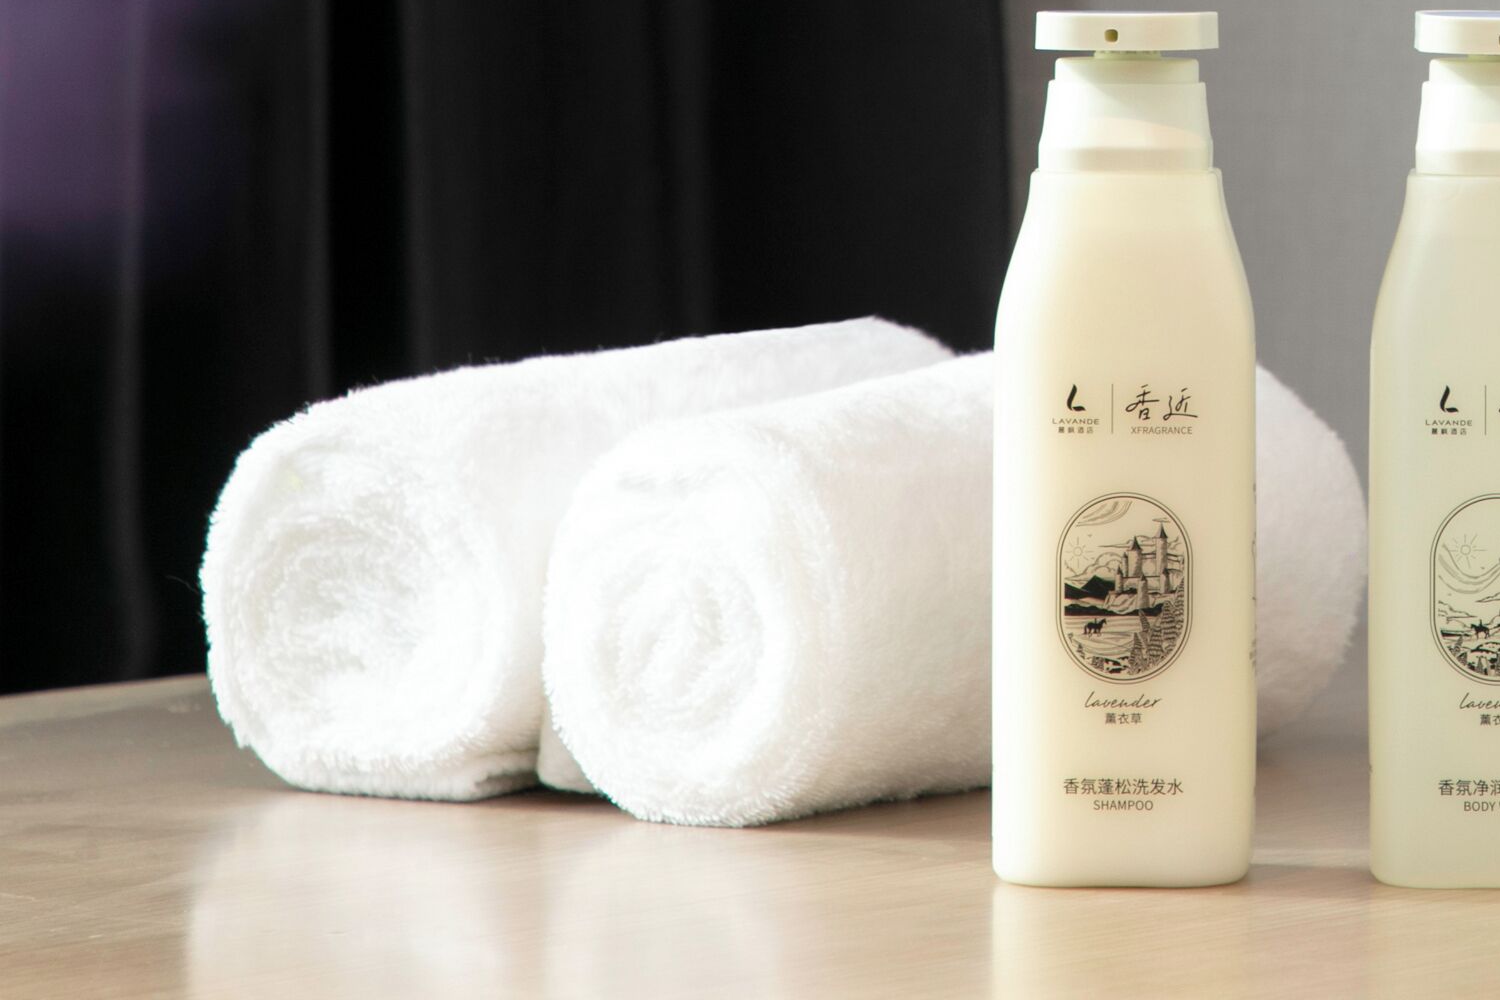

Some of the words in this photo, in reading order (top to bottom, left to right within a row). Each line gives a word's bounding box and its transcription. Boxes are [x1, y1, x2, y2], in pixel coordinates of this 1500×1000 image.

[1052, 418, 1100, 426] LAVANDE
[1425, 419, 1472, 427] LAVANDE
[1130, 426, 1193, 435] XFRAGRANCE
[1084, 690, 1162, 709] lavender
[1105, 712, 1142, 725] 薰衣草
[1063, 778, 1184, 796] 香氛蓬松洗发水
[1093, 799, 1154, 811] SHAMPOO
[1463, 801, 1496, 812] BODY
